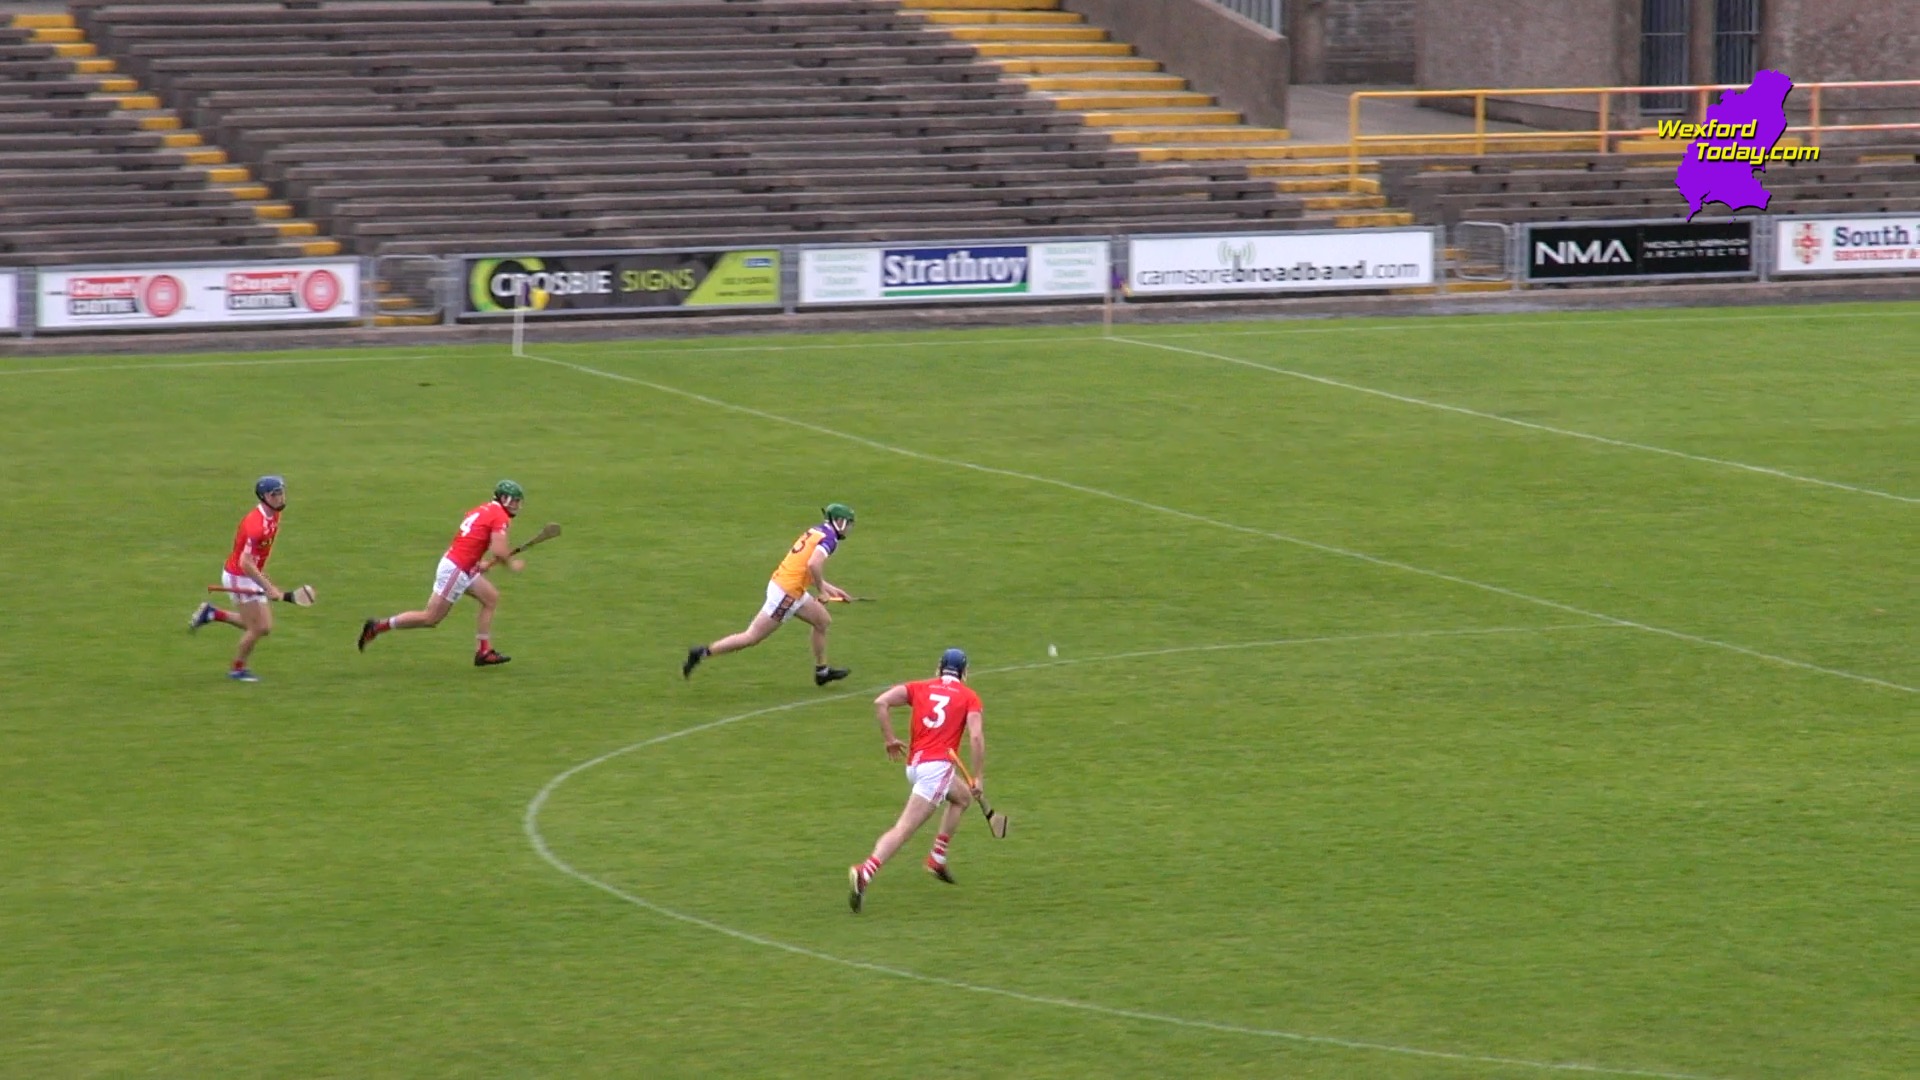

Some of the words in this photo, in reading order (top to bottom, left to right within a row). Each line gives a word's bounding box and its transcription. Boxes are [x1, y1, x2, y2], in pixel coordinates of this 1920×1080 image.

[1834, 225, 1910, 247] South
[1535, 239, 1633, 265] NMA
[884, 250, 1028, 285] Strathroy
[490, 270, 613, 297] CROSBIE
[620, 268, 695, 292] SIGNS
[460, 512, 480, 537] 4
[922, 693, 951, 729] 3
